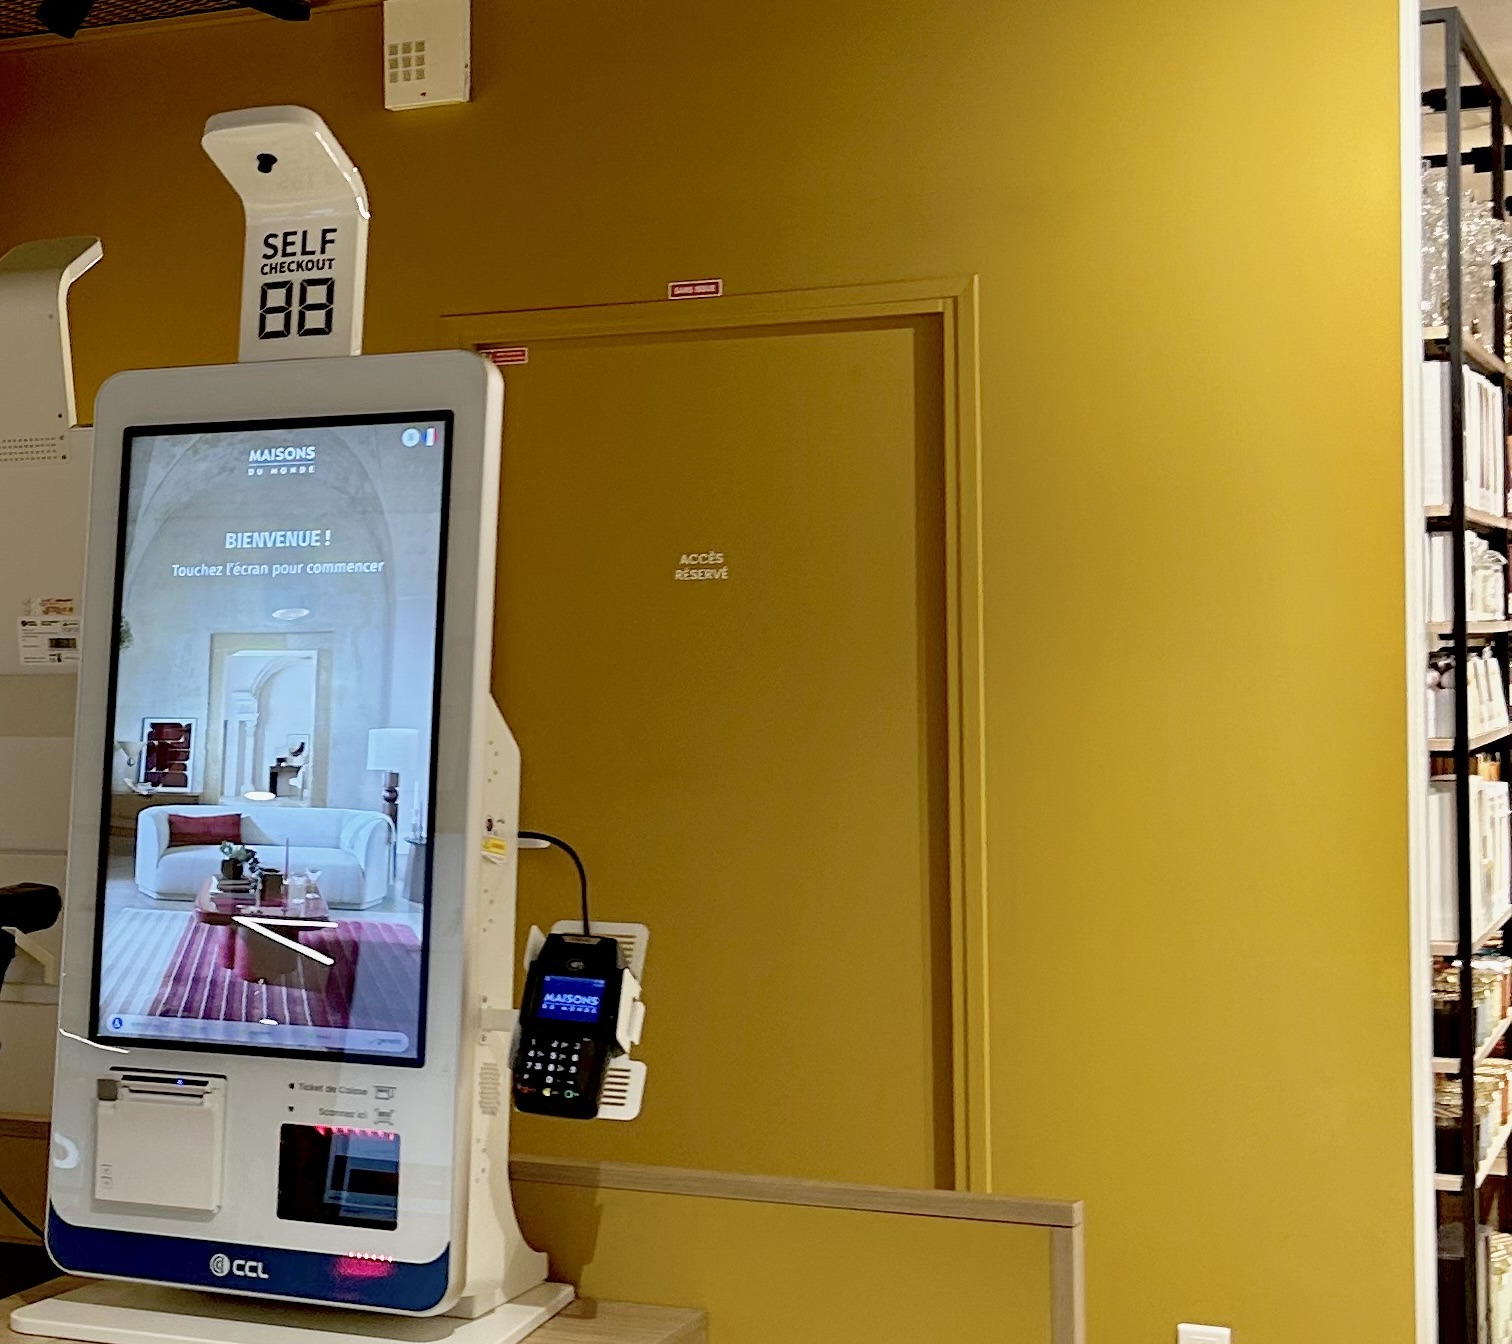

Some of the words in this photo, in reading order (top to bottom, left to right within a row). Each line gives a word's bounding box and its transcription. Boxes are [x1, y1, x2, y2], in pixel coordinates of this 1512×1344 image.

[262, 228, 338, 260] SELF
[260, 258, 336, 276] CHECKOUT
[248, 446, 316, 462] MAISONS
[248, 468, 263, 476] DU
[270, 465, 316, 475] MONDE
[225, 530, 322, 549] BIENVENUE
[325, 529, 331, 546] !
[679, 551, 725, 565] ACCÈS
[172, 563, 223, 577] Touchez
[226, 561, 268, 576] l'écran
[272, 563, 304, 578] pour
[306, 560, 385, 574] commencer
[232, 1259, 269, 1279] CCL
